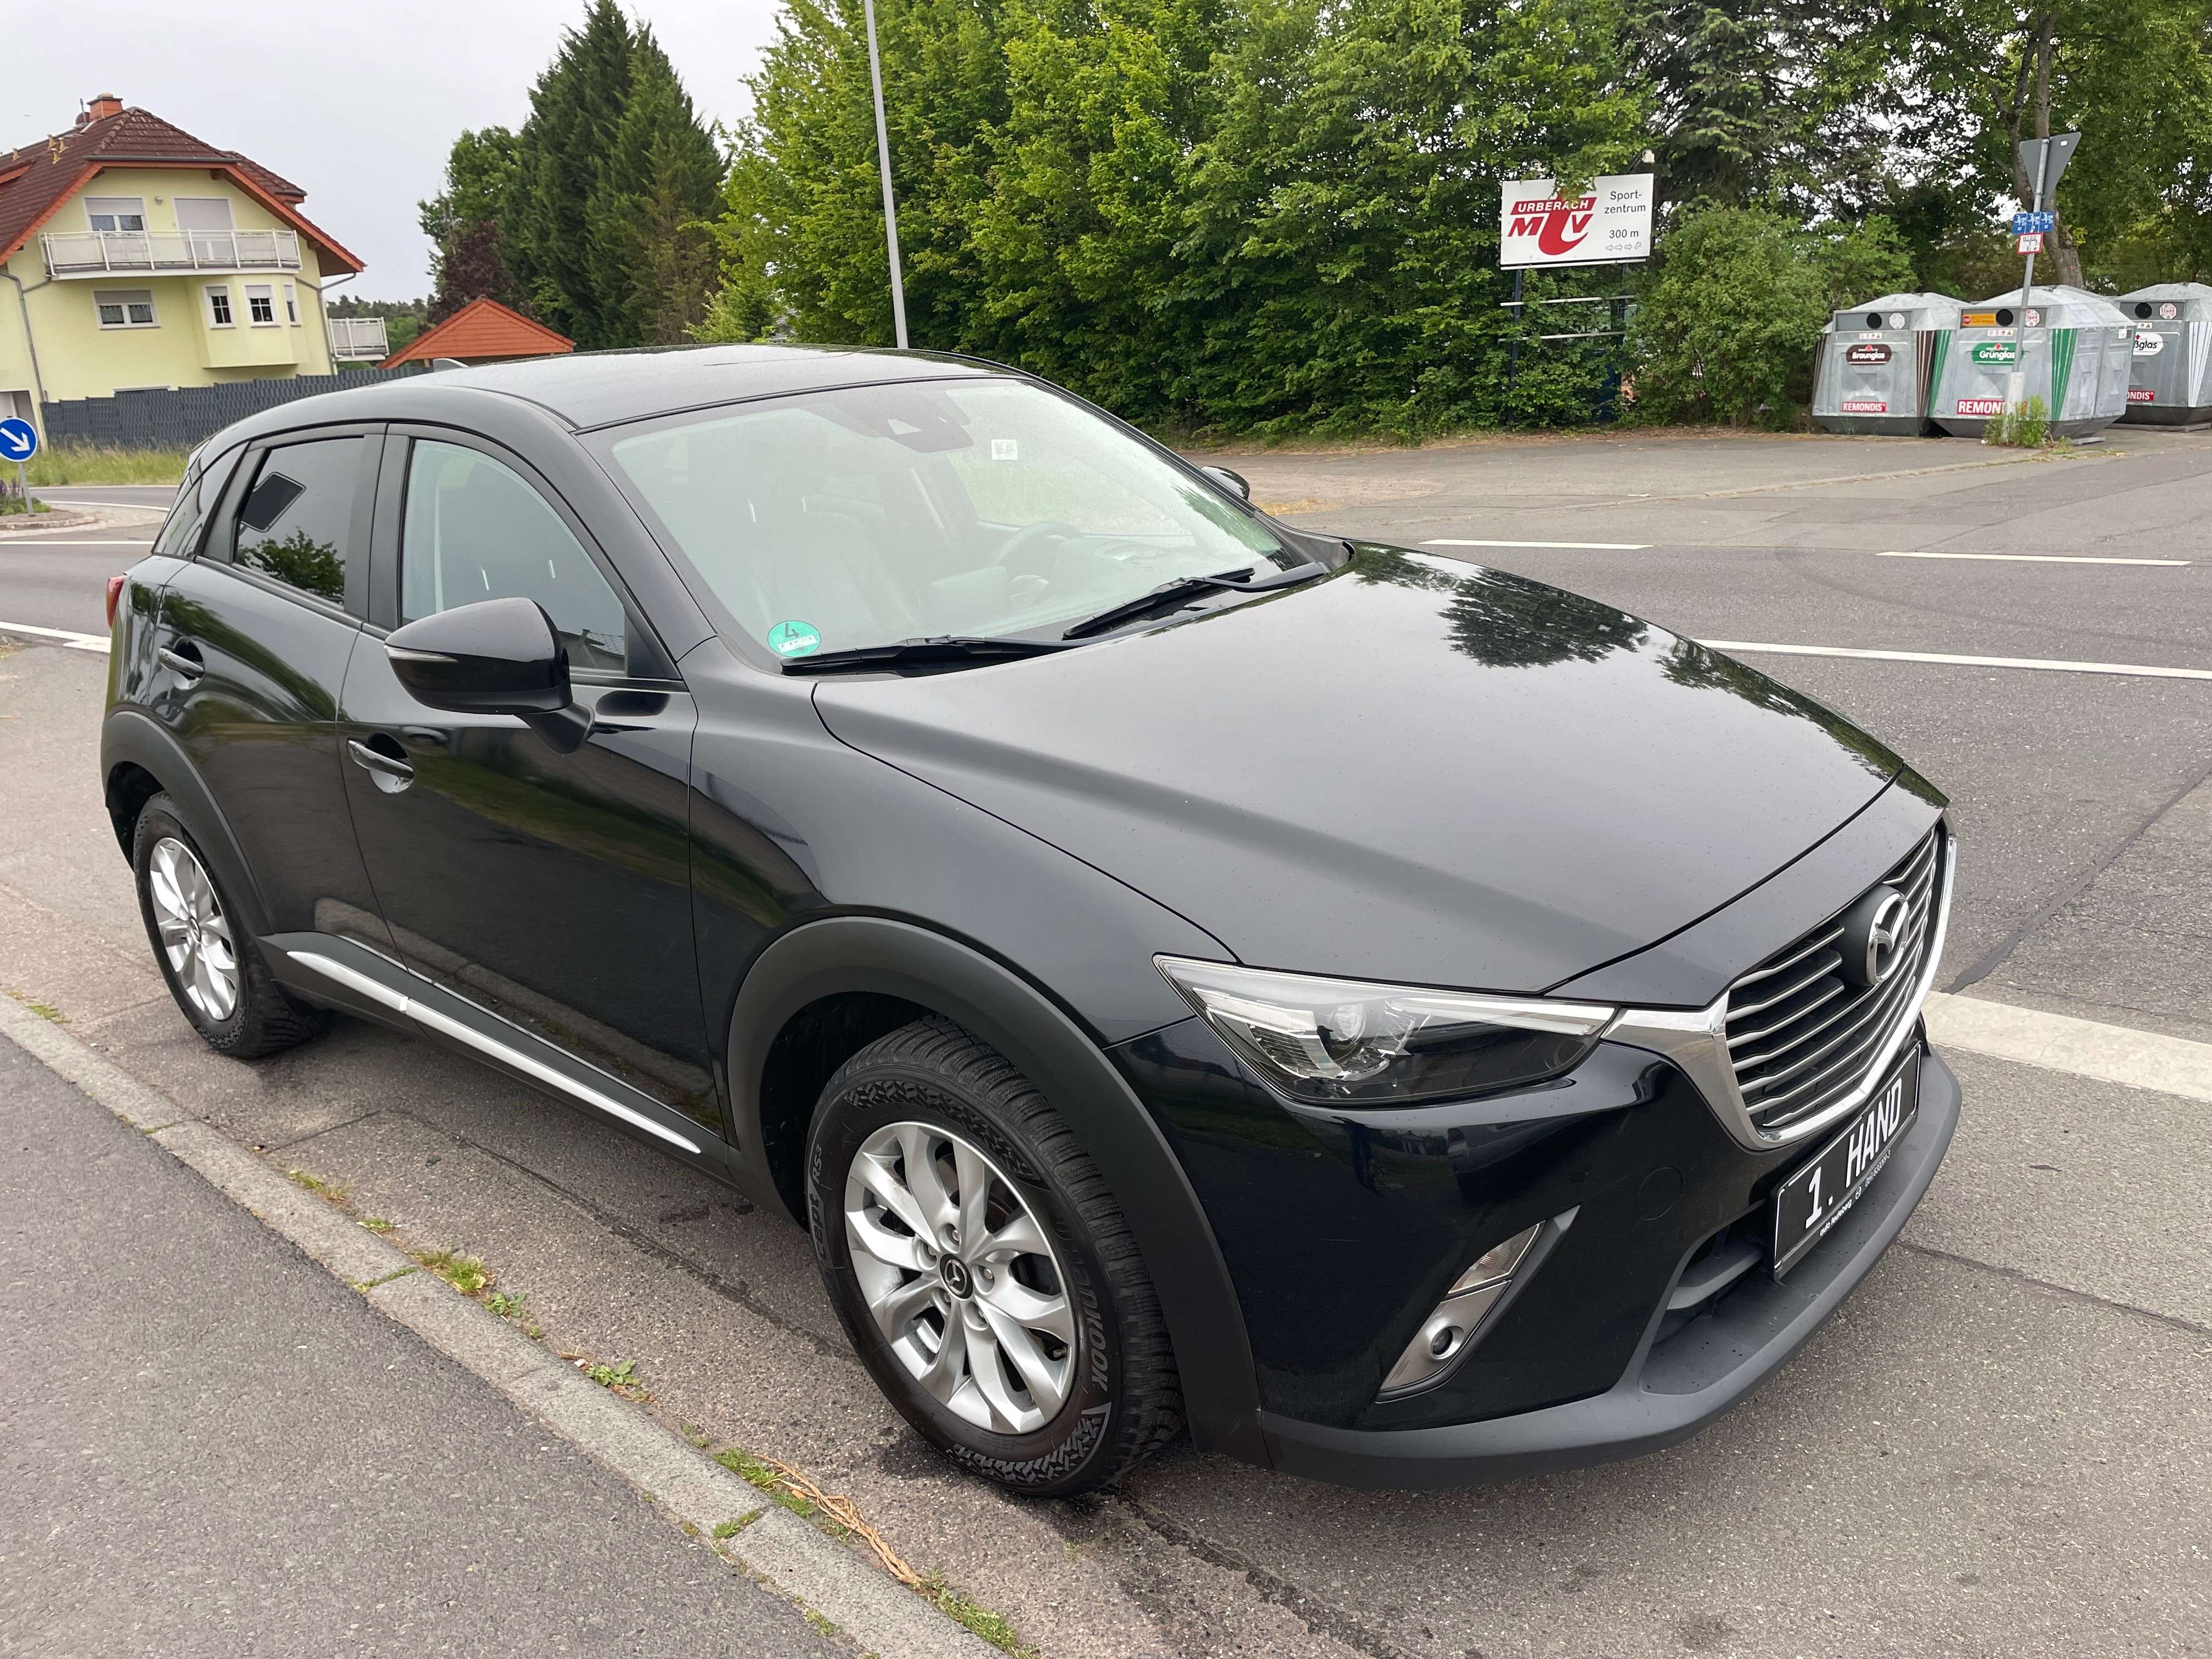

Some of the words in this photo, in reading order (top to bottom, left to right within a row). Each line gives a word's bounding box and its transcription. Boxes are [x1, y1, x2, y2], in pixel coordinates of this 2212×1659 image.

[1610, 191, 1642, 201] Sport-
[1517, 200, 1589, 213] URBERACH
[1604, 204, 1646, 214] zentrum
[1609, 229, 1627, 239] 300
[1852, 352, 1886, 360] Braunglas
[1843, 403, 1883, 411] REMONDIS
[785, 623, 799, 638] 4
[1805, 1166, 1833, 1229] 1.
[1845, 1077, 1902, 1188] HAND
